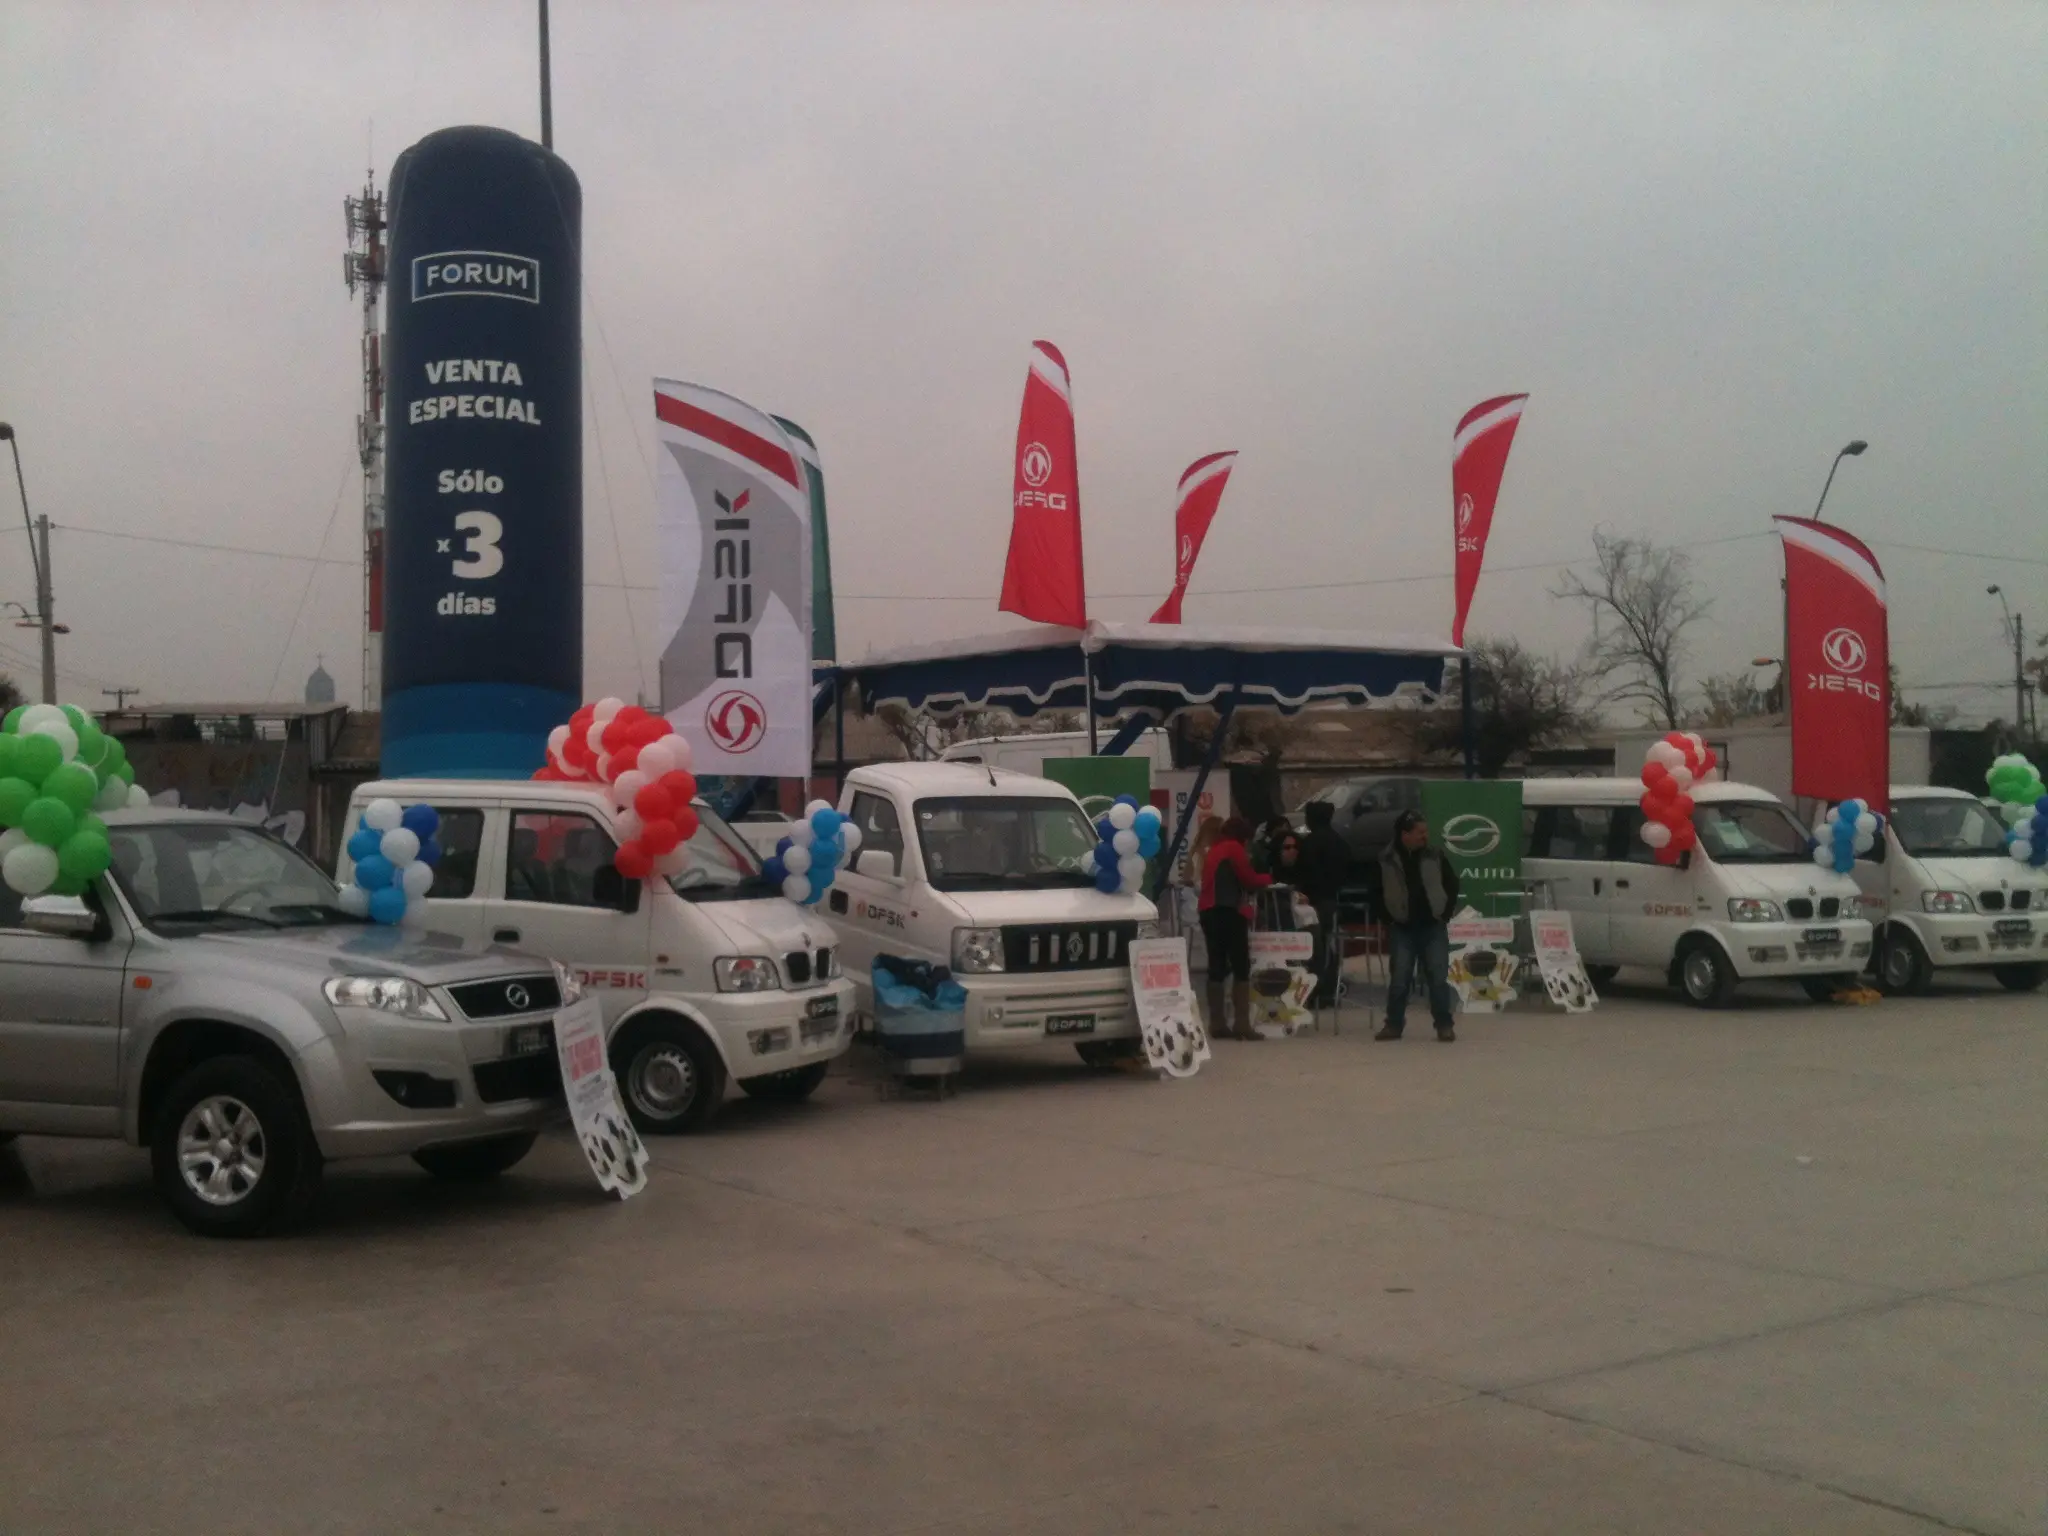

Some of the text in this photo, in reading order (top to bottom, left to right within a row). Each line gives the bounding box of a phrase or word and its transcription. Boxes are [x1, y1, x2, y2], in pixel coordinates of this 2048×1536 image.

[426, 262, 528, 290] FORUM
[425, 359, 523, 386] VENTA
[408, 395, 541, 426] ESPECIAL
[437, 469, 504, 494] Sólo
[436, 510, 504, 580] x 3
[436, 592, 496, 616] días
[1460, 867, 1515, 879] AUTO
[867, 904, 906, 930] DFSK
